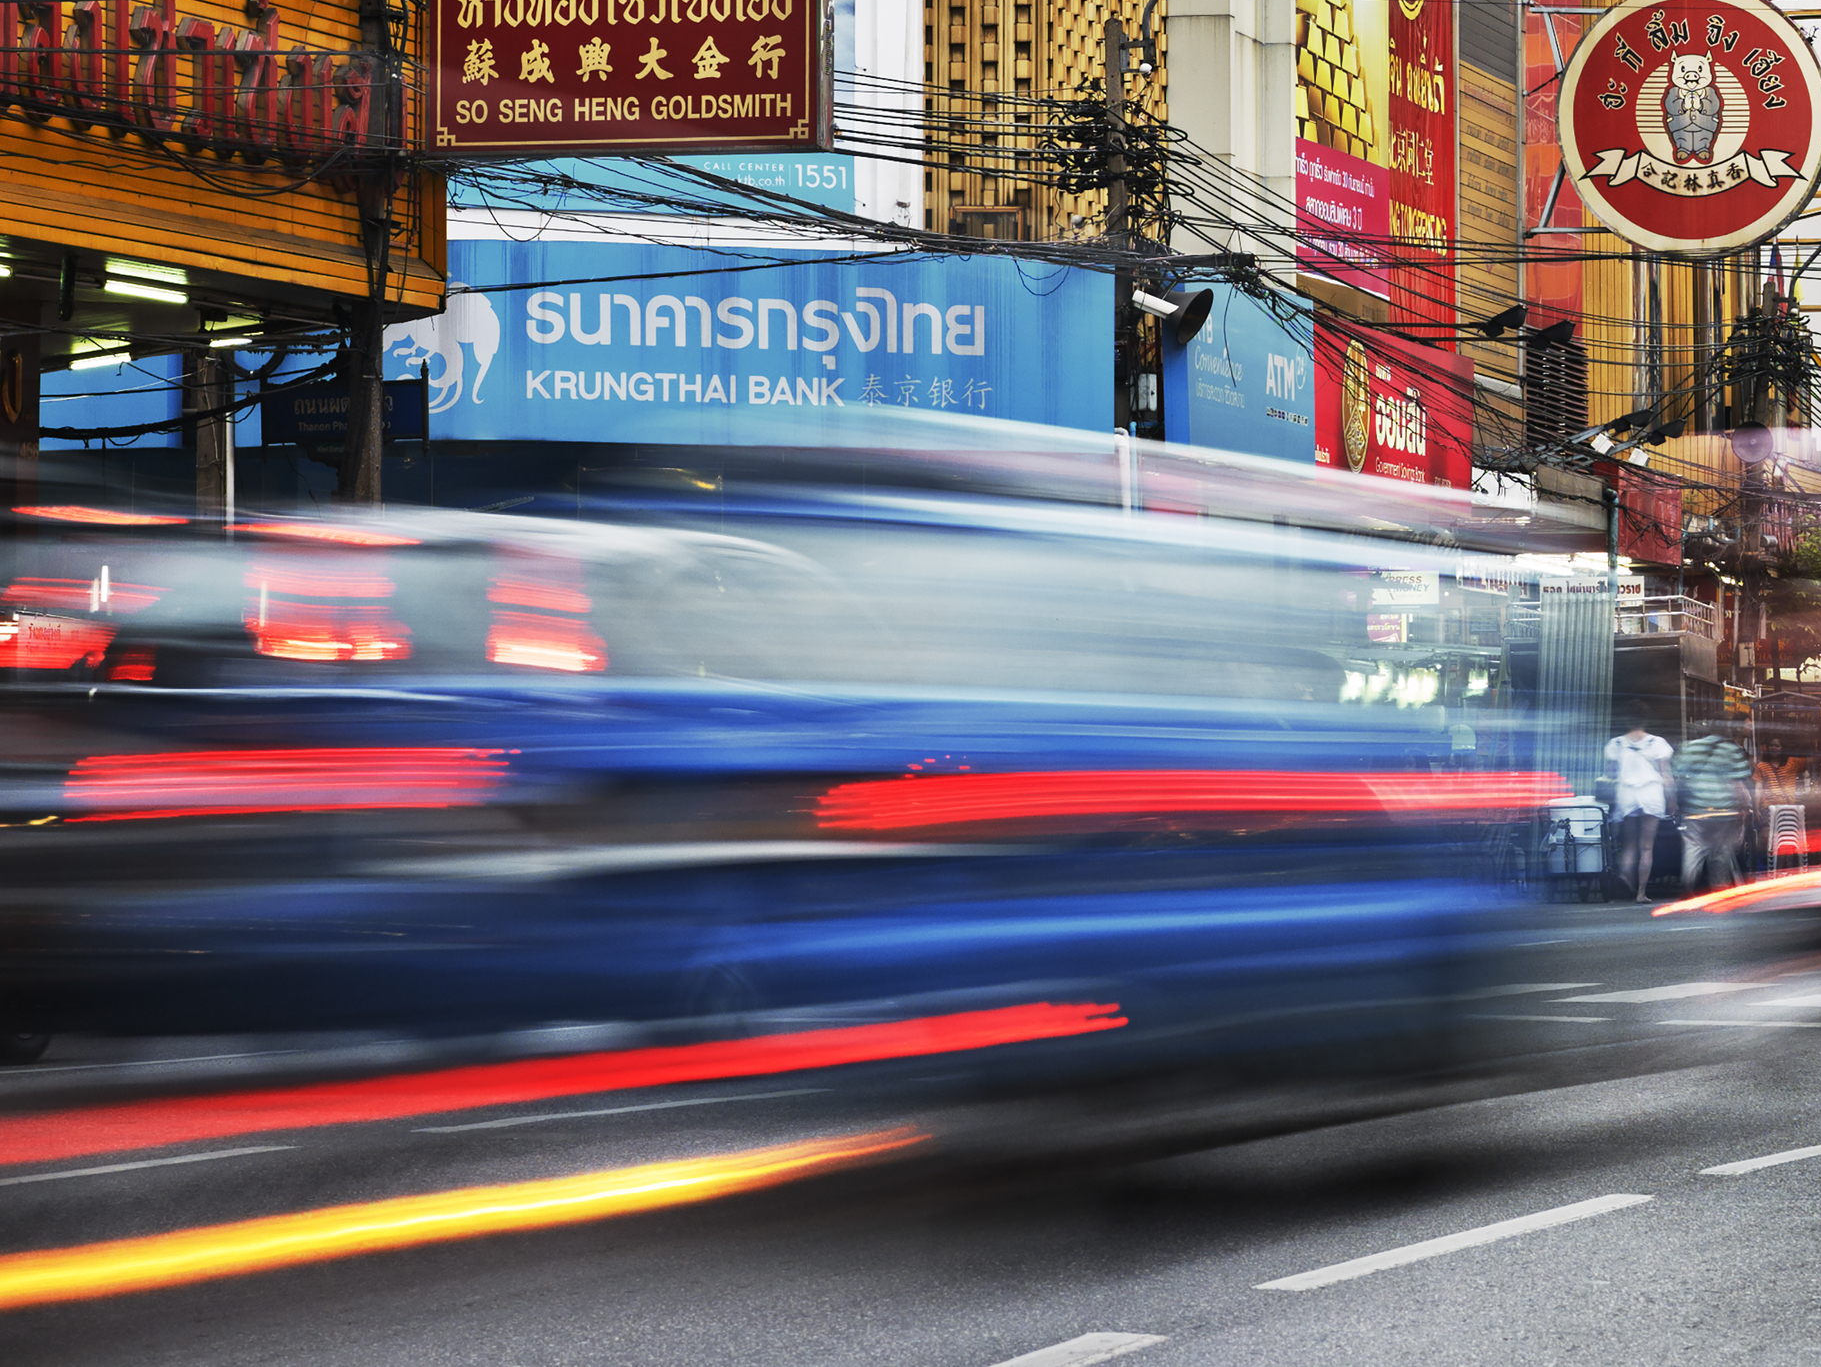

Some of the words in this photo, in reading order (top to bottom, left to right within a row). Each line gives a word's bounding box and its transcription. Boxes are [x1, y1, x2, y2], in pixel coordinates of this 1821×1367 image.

[461, 34, 787, 86] 蘇成興大金行
[455, 99, 489, 125] SO
[498, 97, 563, 123] SENG
[573, 95, 640, 122] HENG
[650, 92, 792, 120] GOLDSMITH
[703, 161, 732, 171] CALL
[738, 161, 786, 172] CENTER
[794, 163, 848, 190] 1551
[525, 286, 986, 371] ธนาคารกรุงไทย
[526, 369, 737, 405] KRUNGTHAI
[748, 375, 845, 408] BANK
[1266, 353, 1296, 402] ATM
